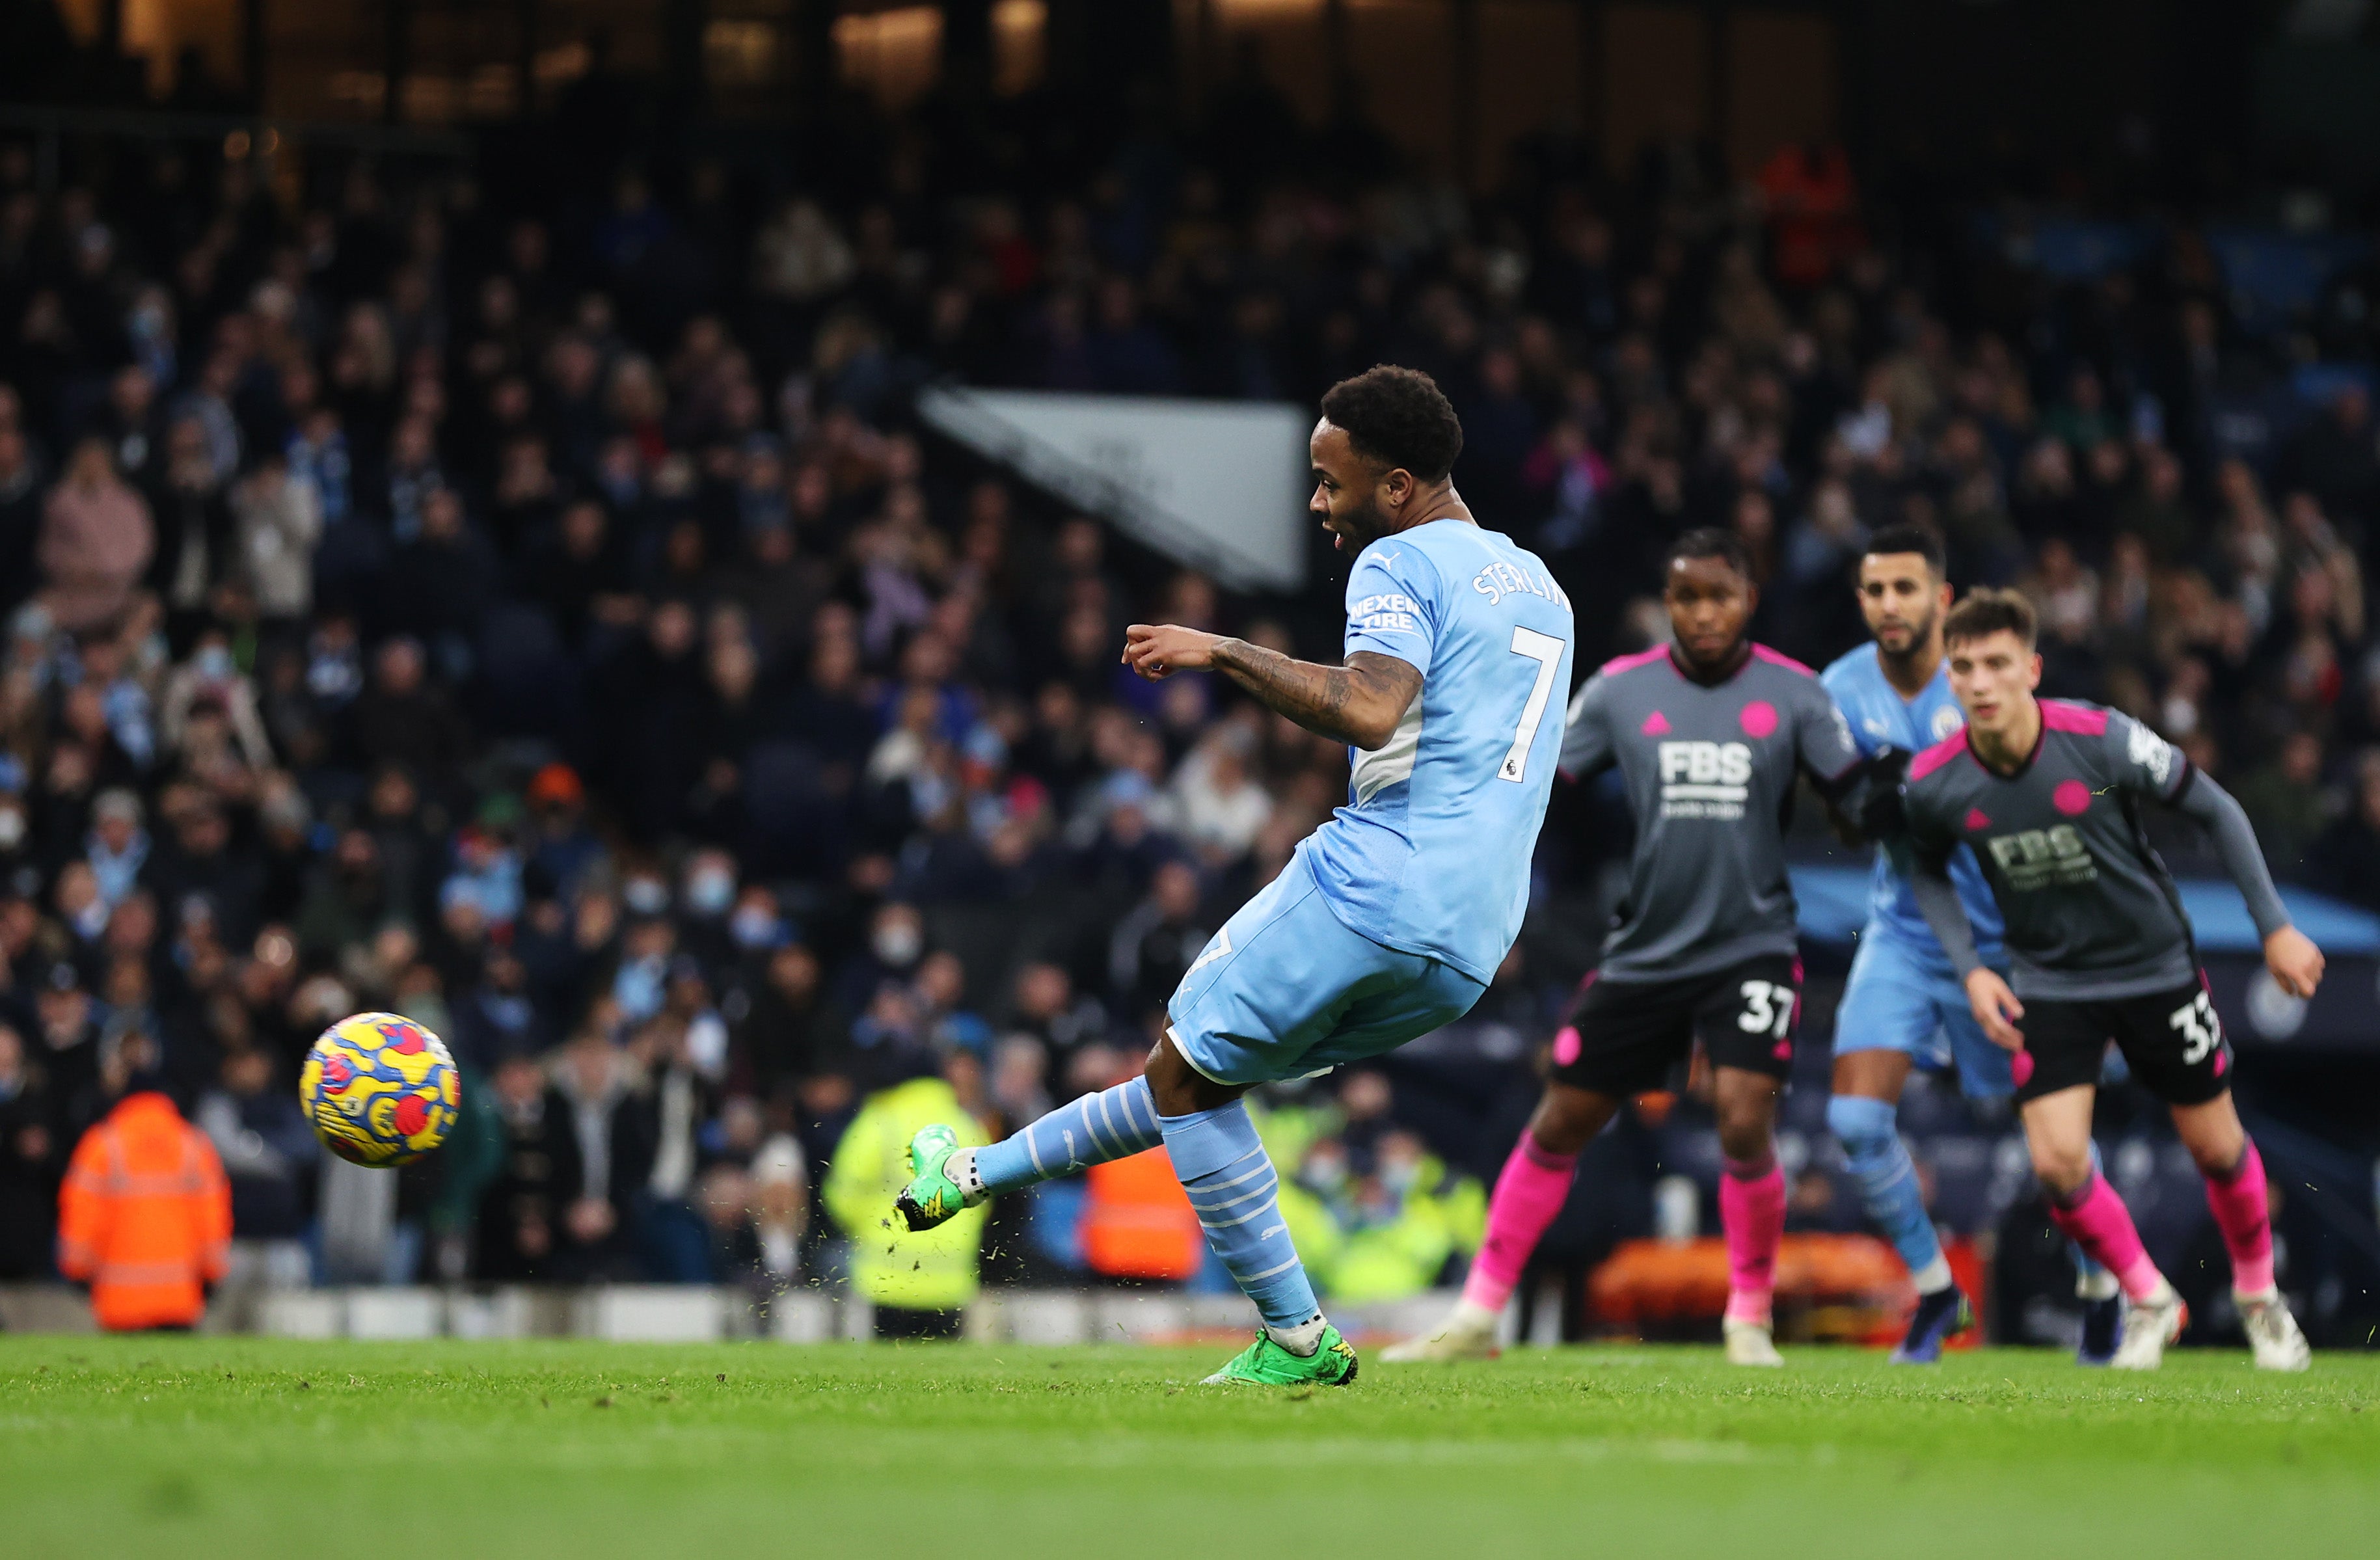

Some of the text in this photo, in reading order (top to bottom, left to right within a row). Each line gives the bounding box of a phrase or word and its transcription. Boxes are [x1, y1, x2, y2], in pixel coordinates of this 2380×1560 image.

[1350, 593, 1420, 621] NEXEN
[1360, 612, 1413, 630] TIRE
[1496, 625, 1565, 783] 7
[1658, 740, 1752, 785] FBS
[1988, 824, 2083, 868] FBS
[1187, 925, 1233, 976] 7
[1737, 980, 1795, 1039] 37
[2169, 989, 2221, 1065] 33
